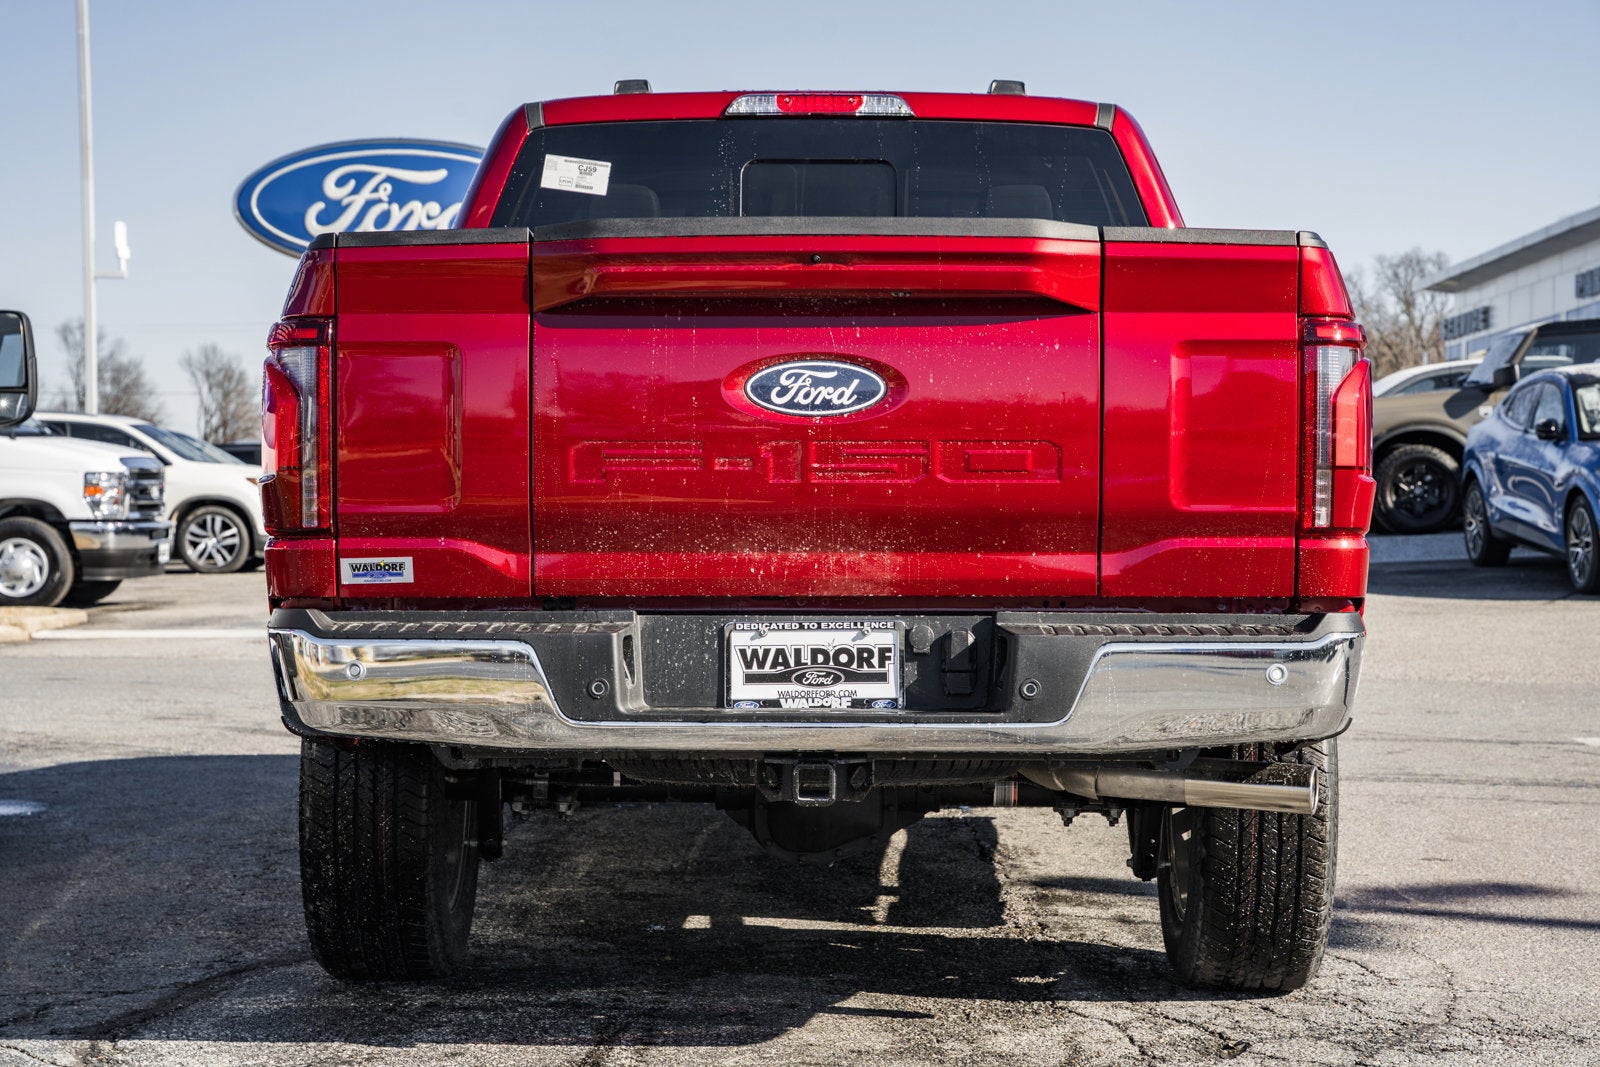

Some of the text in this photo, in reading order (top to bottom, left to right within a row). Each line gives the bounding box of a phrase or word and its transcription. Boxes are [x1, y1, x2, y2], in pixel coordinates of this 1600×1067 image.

[578, 165, 597, 173] CJ59
[304, 164, 462, 236] For
[771, 369, 860, 405] Ford
[569, 440, 1063, 483] F-150
[350, 562, 405, 572] WALDORF
[735, 621, 894, 630] DEDICATED TO EXCELLENCE
[736, 646, 894, 670] WALDORF
[802, 671, 833, 685] Ford
[777, 690, 857, 698] WALDORFFORD.COM
[779, 697, 852, 708] WALDORF
